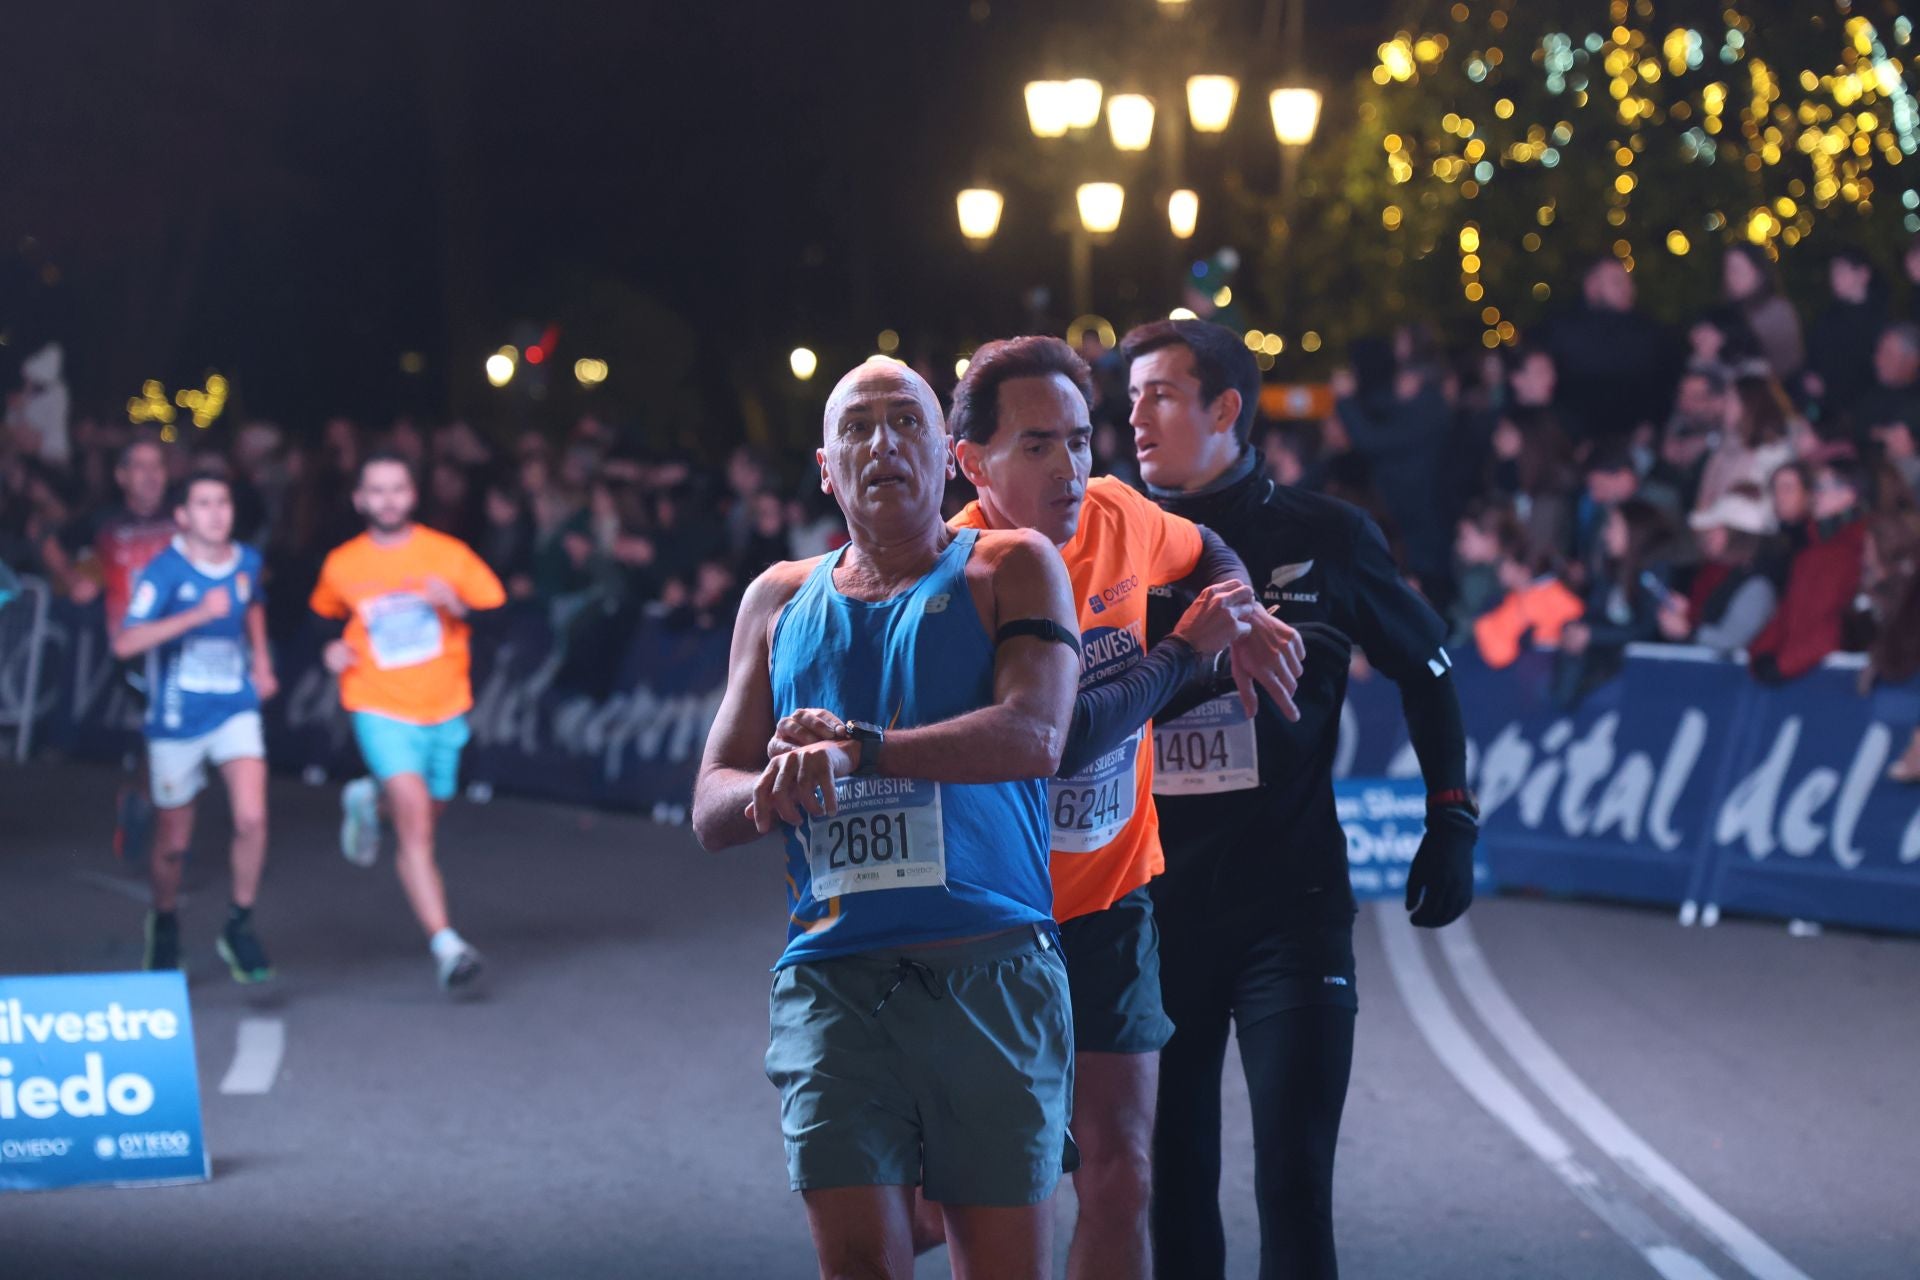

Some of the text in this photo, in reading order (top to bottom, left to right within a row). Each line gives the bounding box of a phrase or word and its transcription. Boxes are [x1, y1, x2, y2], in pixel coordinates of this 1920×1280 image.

[1103, 575, 1138, 602] OVIEDO
[1264, 591, 1318, 603] ALL BLACKS
[1154, 729, 1229, 772] 1404
[854, 778, 915, 798] SILVESTRE
[1054, 778, 1119, 830] 6244
[1714, 714, 1892, 868] del
[829, 812, 908, 868] 2681
[0, 998, 178, 1044] ilvestre
[0, 1051, 155, 1119] iedo
[2, 1130, 190, 1159] OVIEDO OVIEDO
